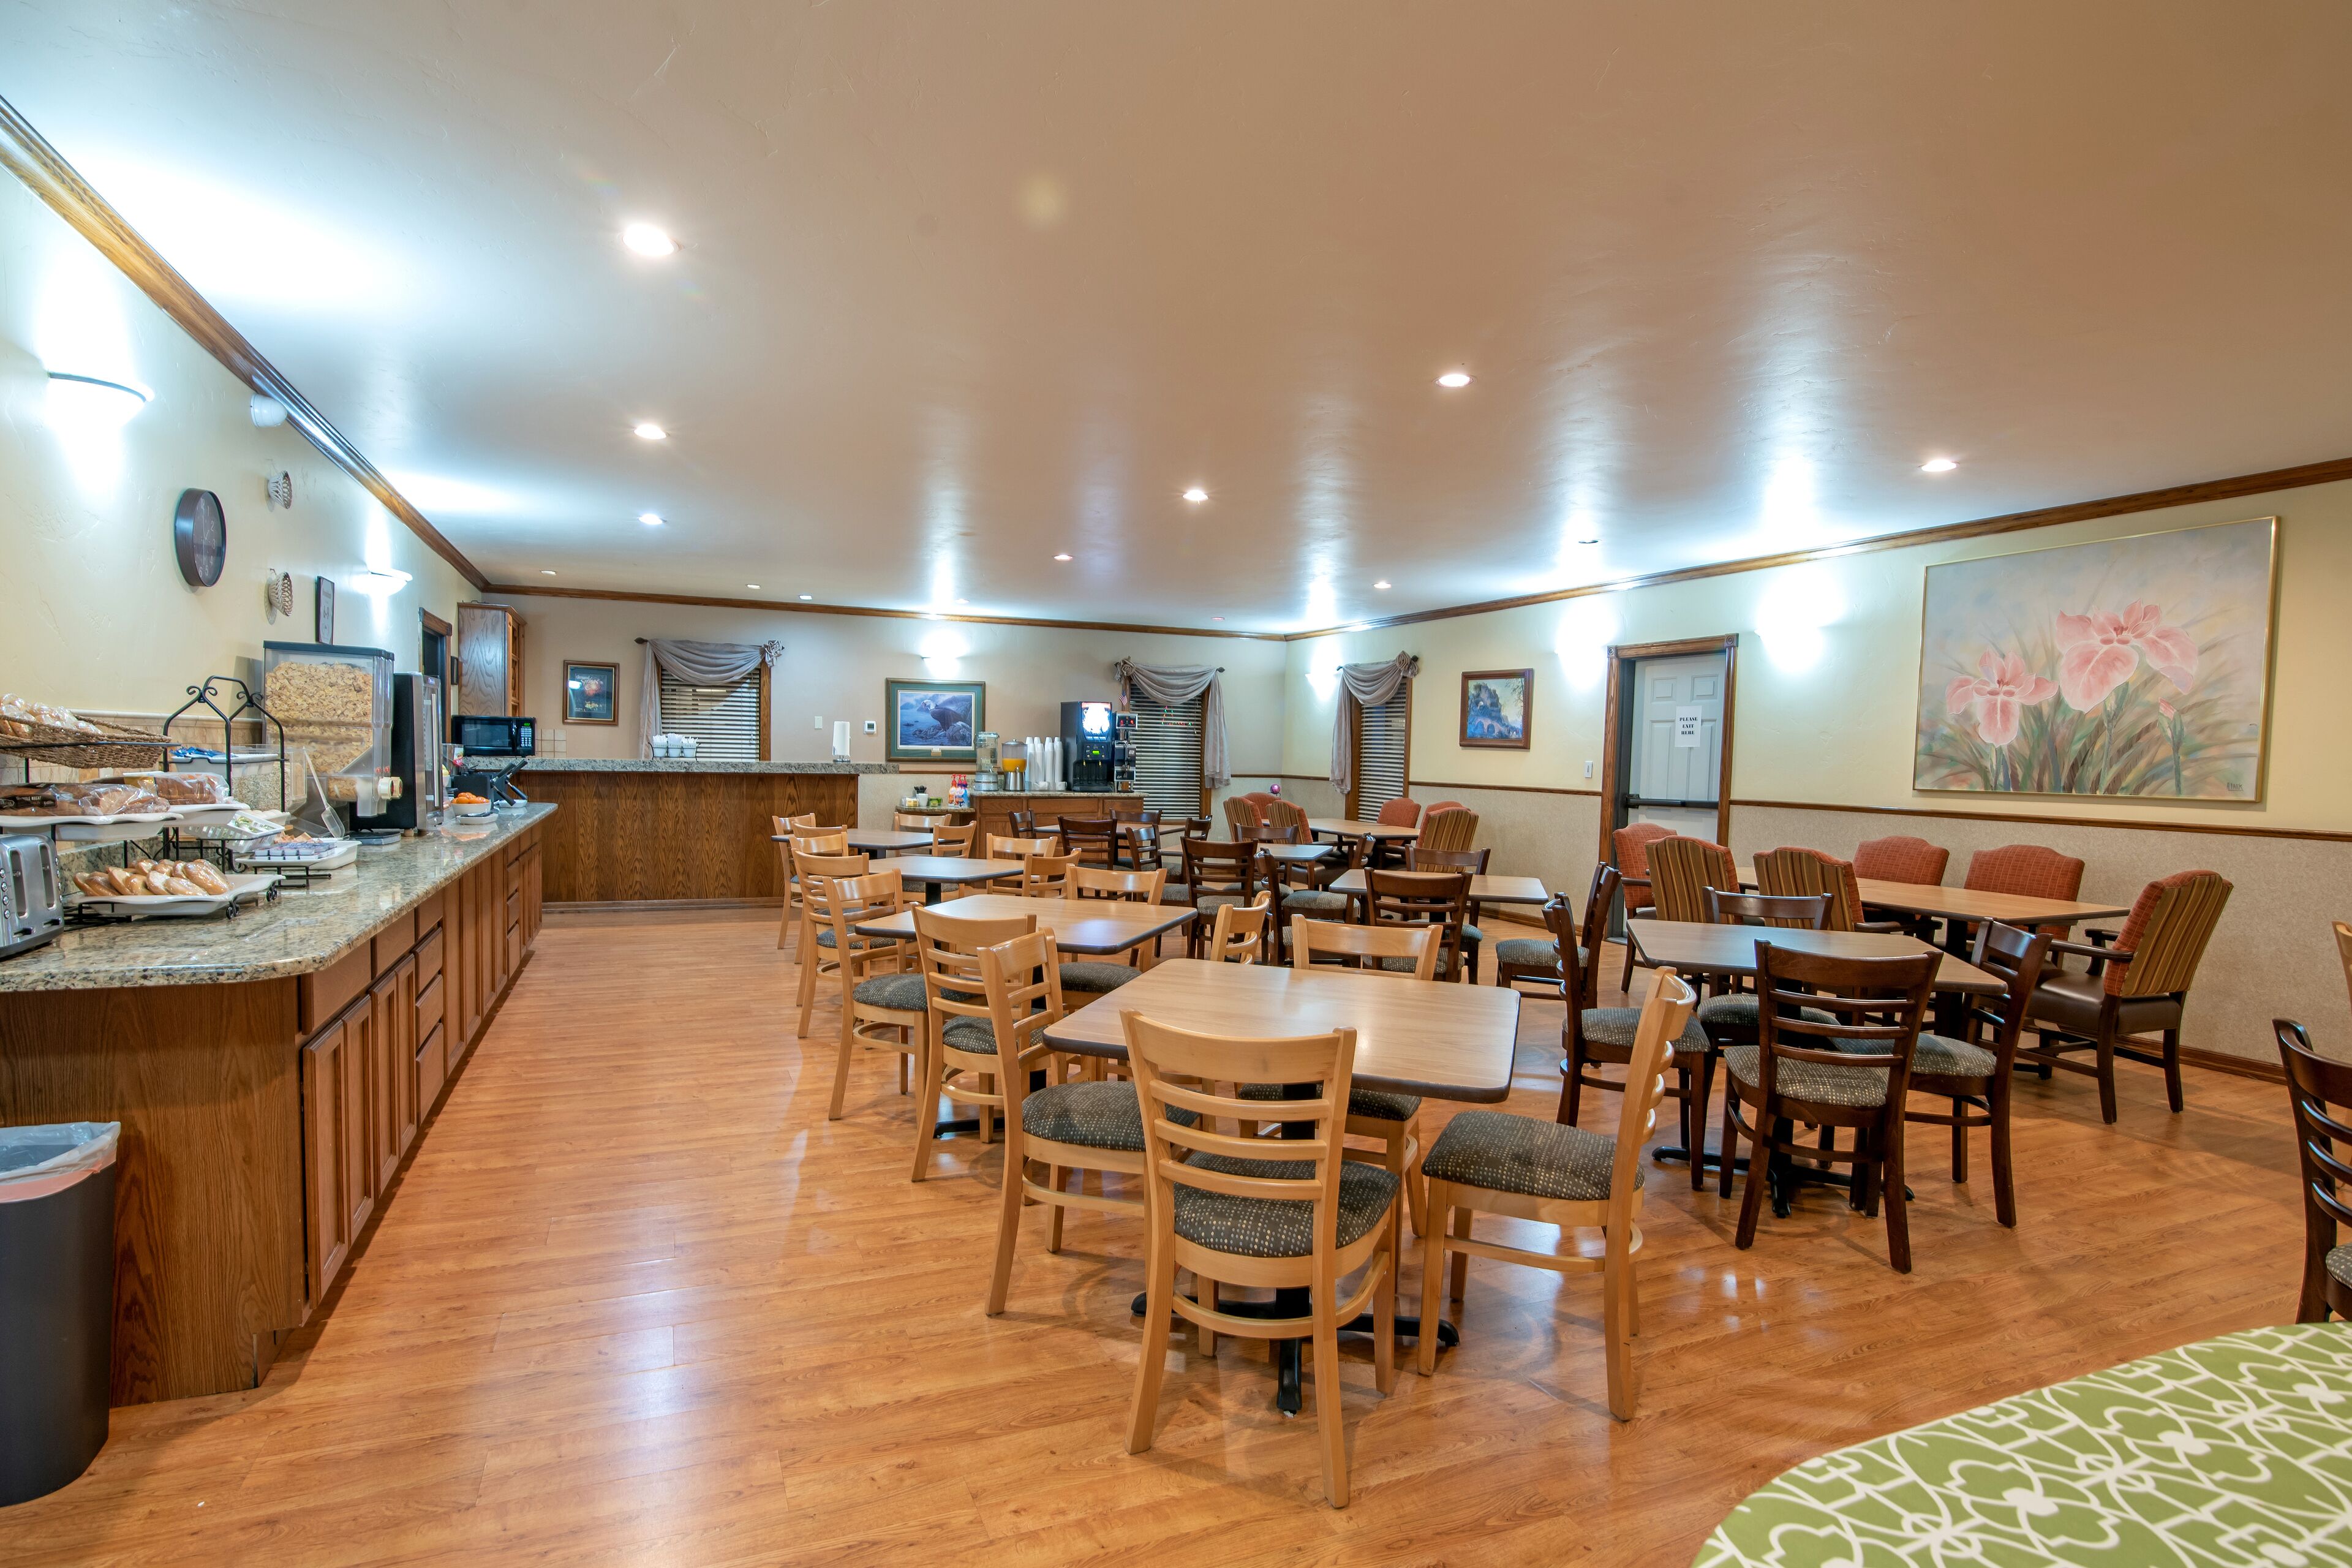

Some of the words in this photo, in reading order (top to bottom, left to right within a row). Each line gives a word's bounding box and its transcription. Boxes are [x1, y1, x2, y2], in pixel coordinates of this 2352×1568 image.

[211, 521, 214, 532] 2
[212, 539, 216, 549] 3
[209, 556, 213, 566] 4
[199, 566, 203, 577] 6
[205, 565, 209, 576] 5
